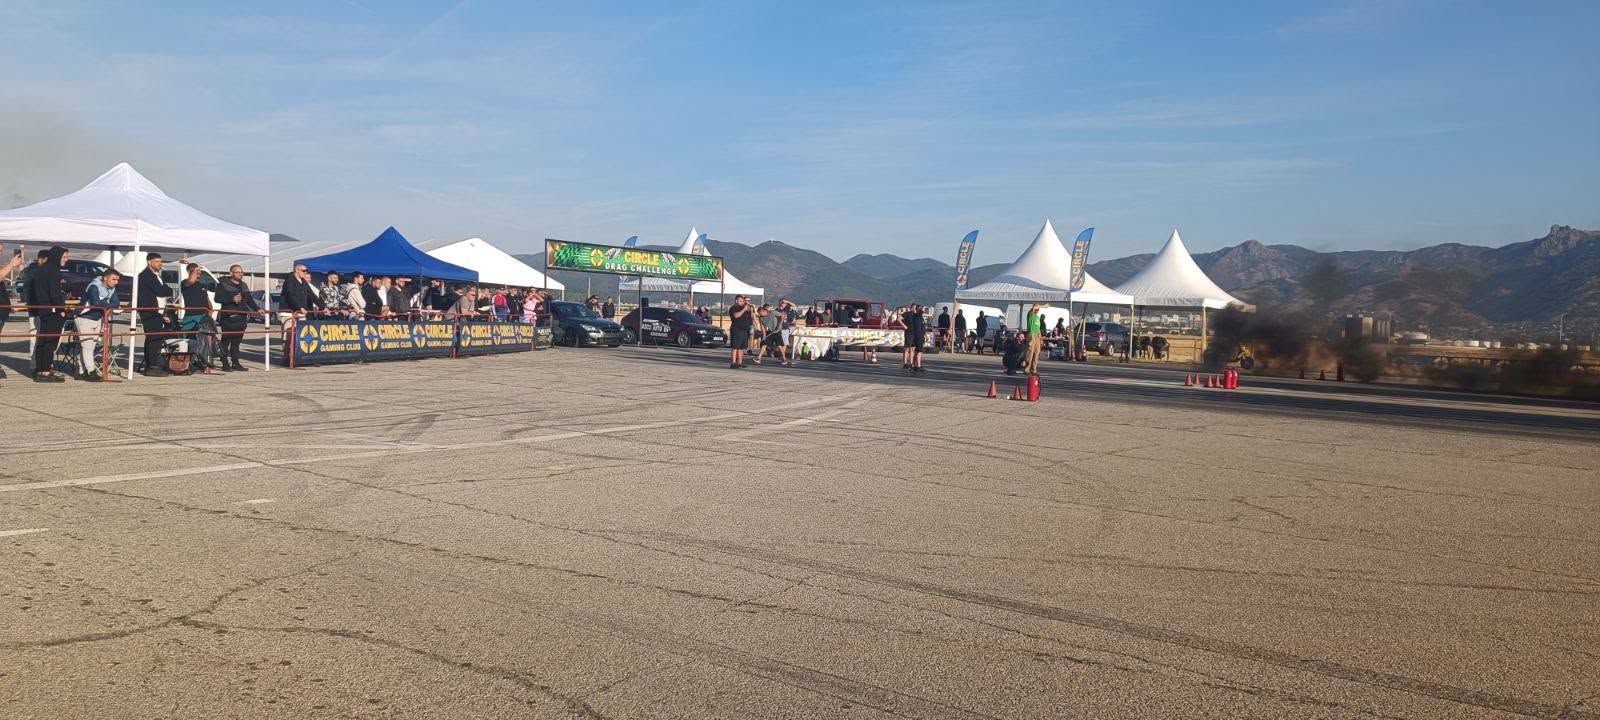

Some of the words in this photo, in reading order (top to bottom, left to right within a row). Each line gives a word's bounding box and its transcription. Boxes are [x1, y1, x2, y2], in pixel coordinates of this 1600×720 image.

[624, 251, 660, 266] CIRCLE
[958, 242, 969, 273] CIRCLE
[1072, 240, 1084, 274] CIRCLE
[605, 262, 628, 271] DRAG
[630, 264, 677, 275] CHALLENGE
[320, 324, 360, 341] CIRCLE
[378, 324, 410, 340] CIRCLE
[425, 324, 454, 338] CIRCLE
[471, 324, 492, 338] CIRCLE
[320, 343, 345, 352] GAMING
[346, 343, 361, 351] CLUB
[381, 341, 400, 349] GAMING
[400, 341, 412, 349] CLUB
